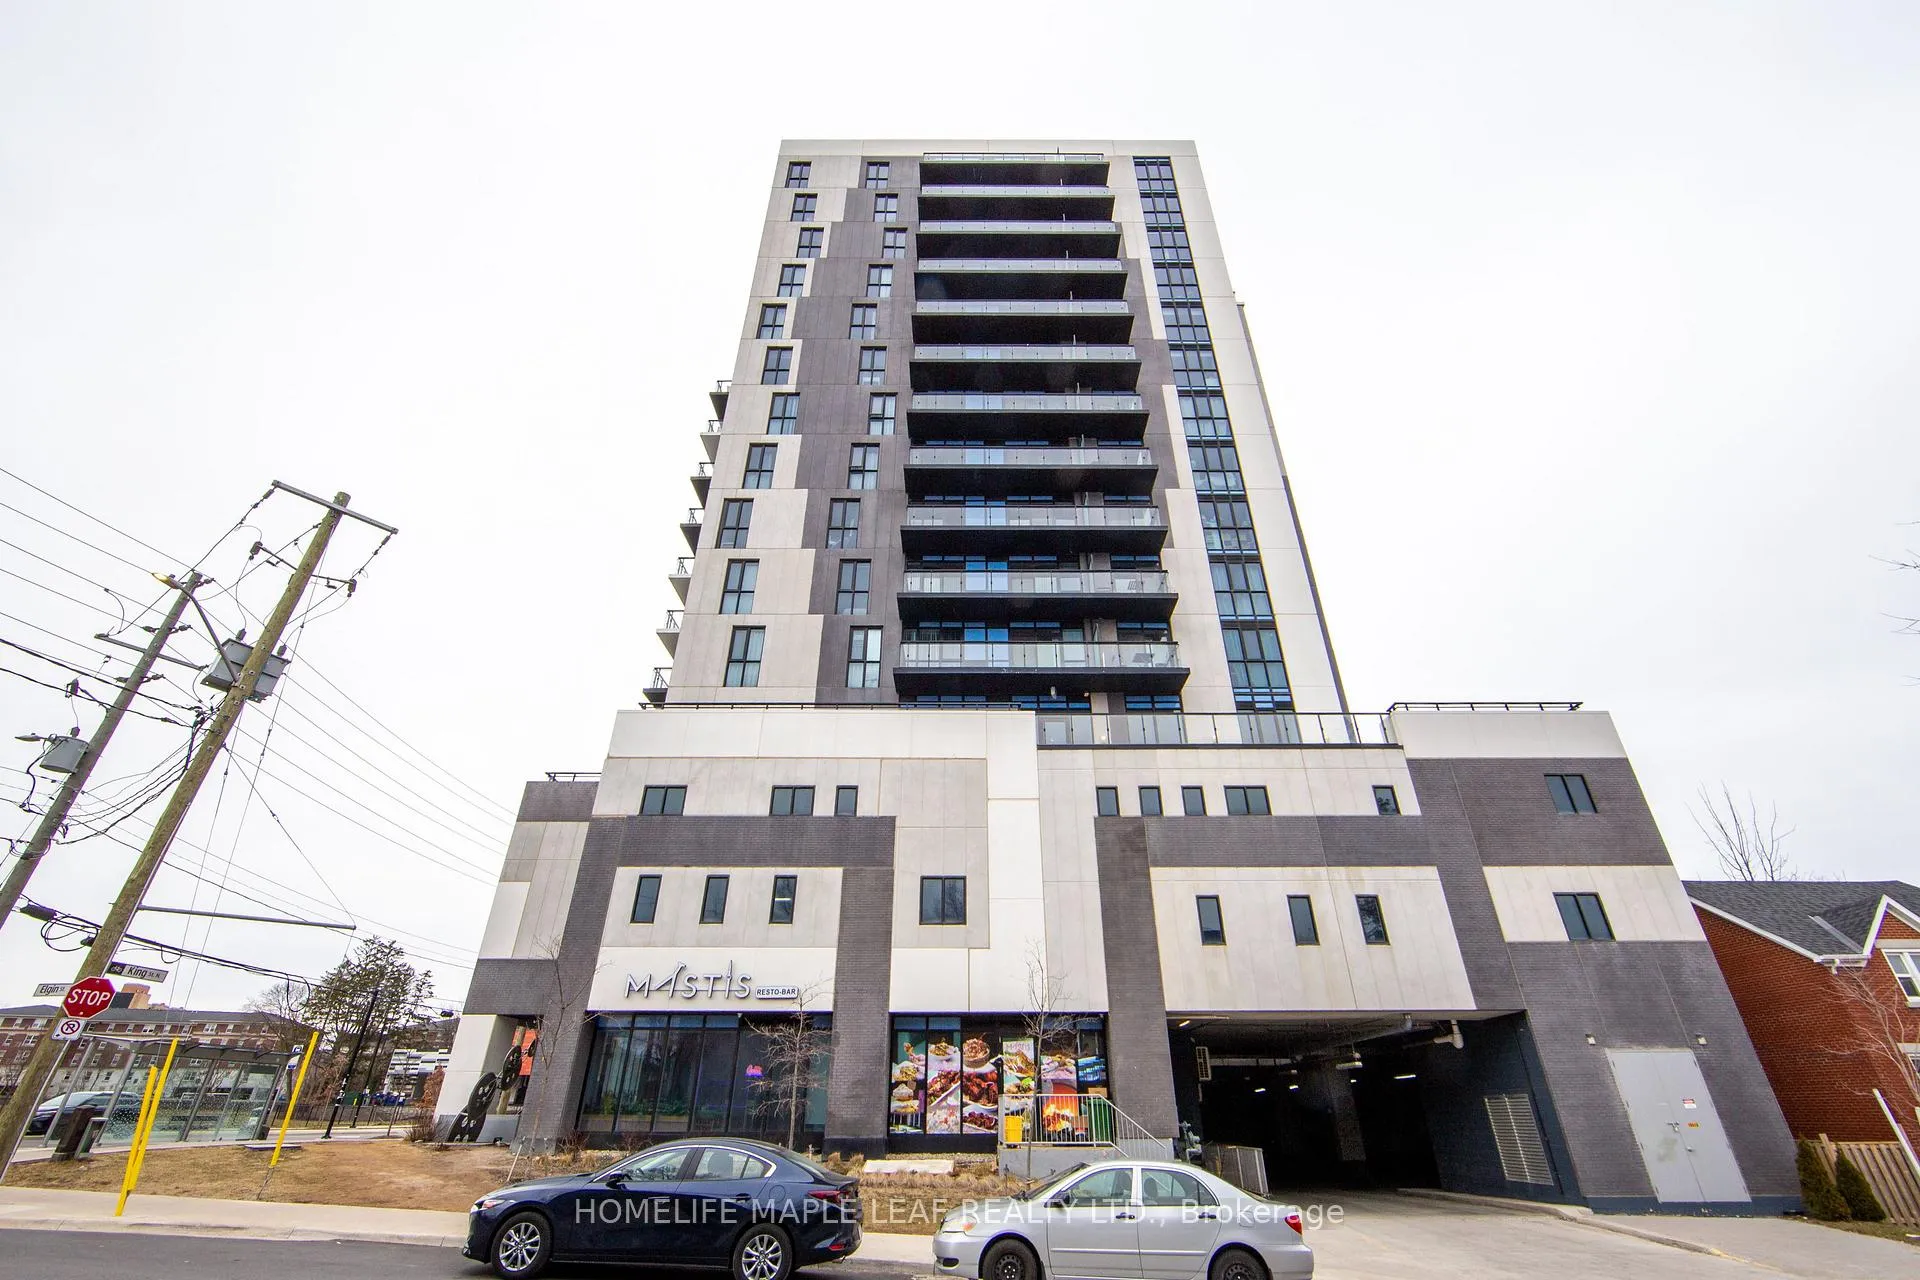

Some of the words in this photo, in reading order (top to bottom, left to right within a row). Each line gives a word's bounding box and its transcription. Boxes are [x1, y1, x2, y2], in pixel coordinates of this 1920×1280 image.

[127, 966, 147, 979] King
[40, 985, 59, 996] Elgin
[756, 988, 796, 996] RESTO-BAR
[67, 988, 111, 1006] STOP
